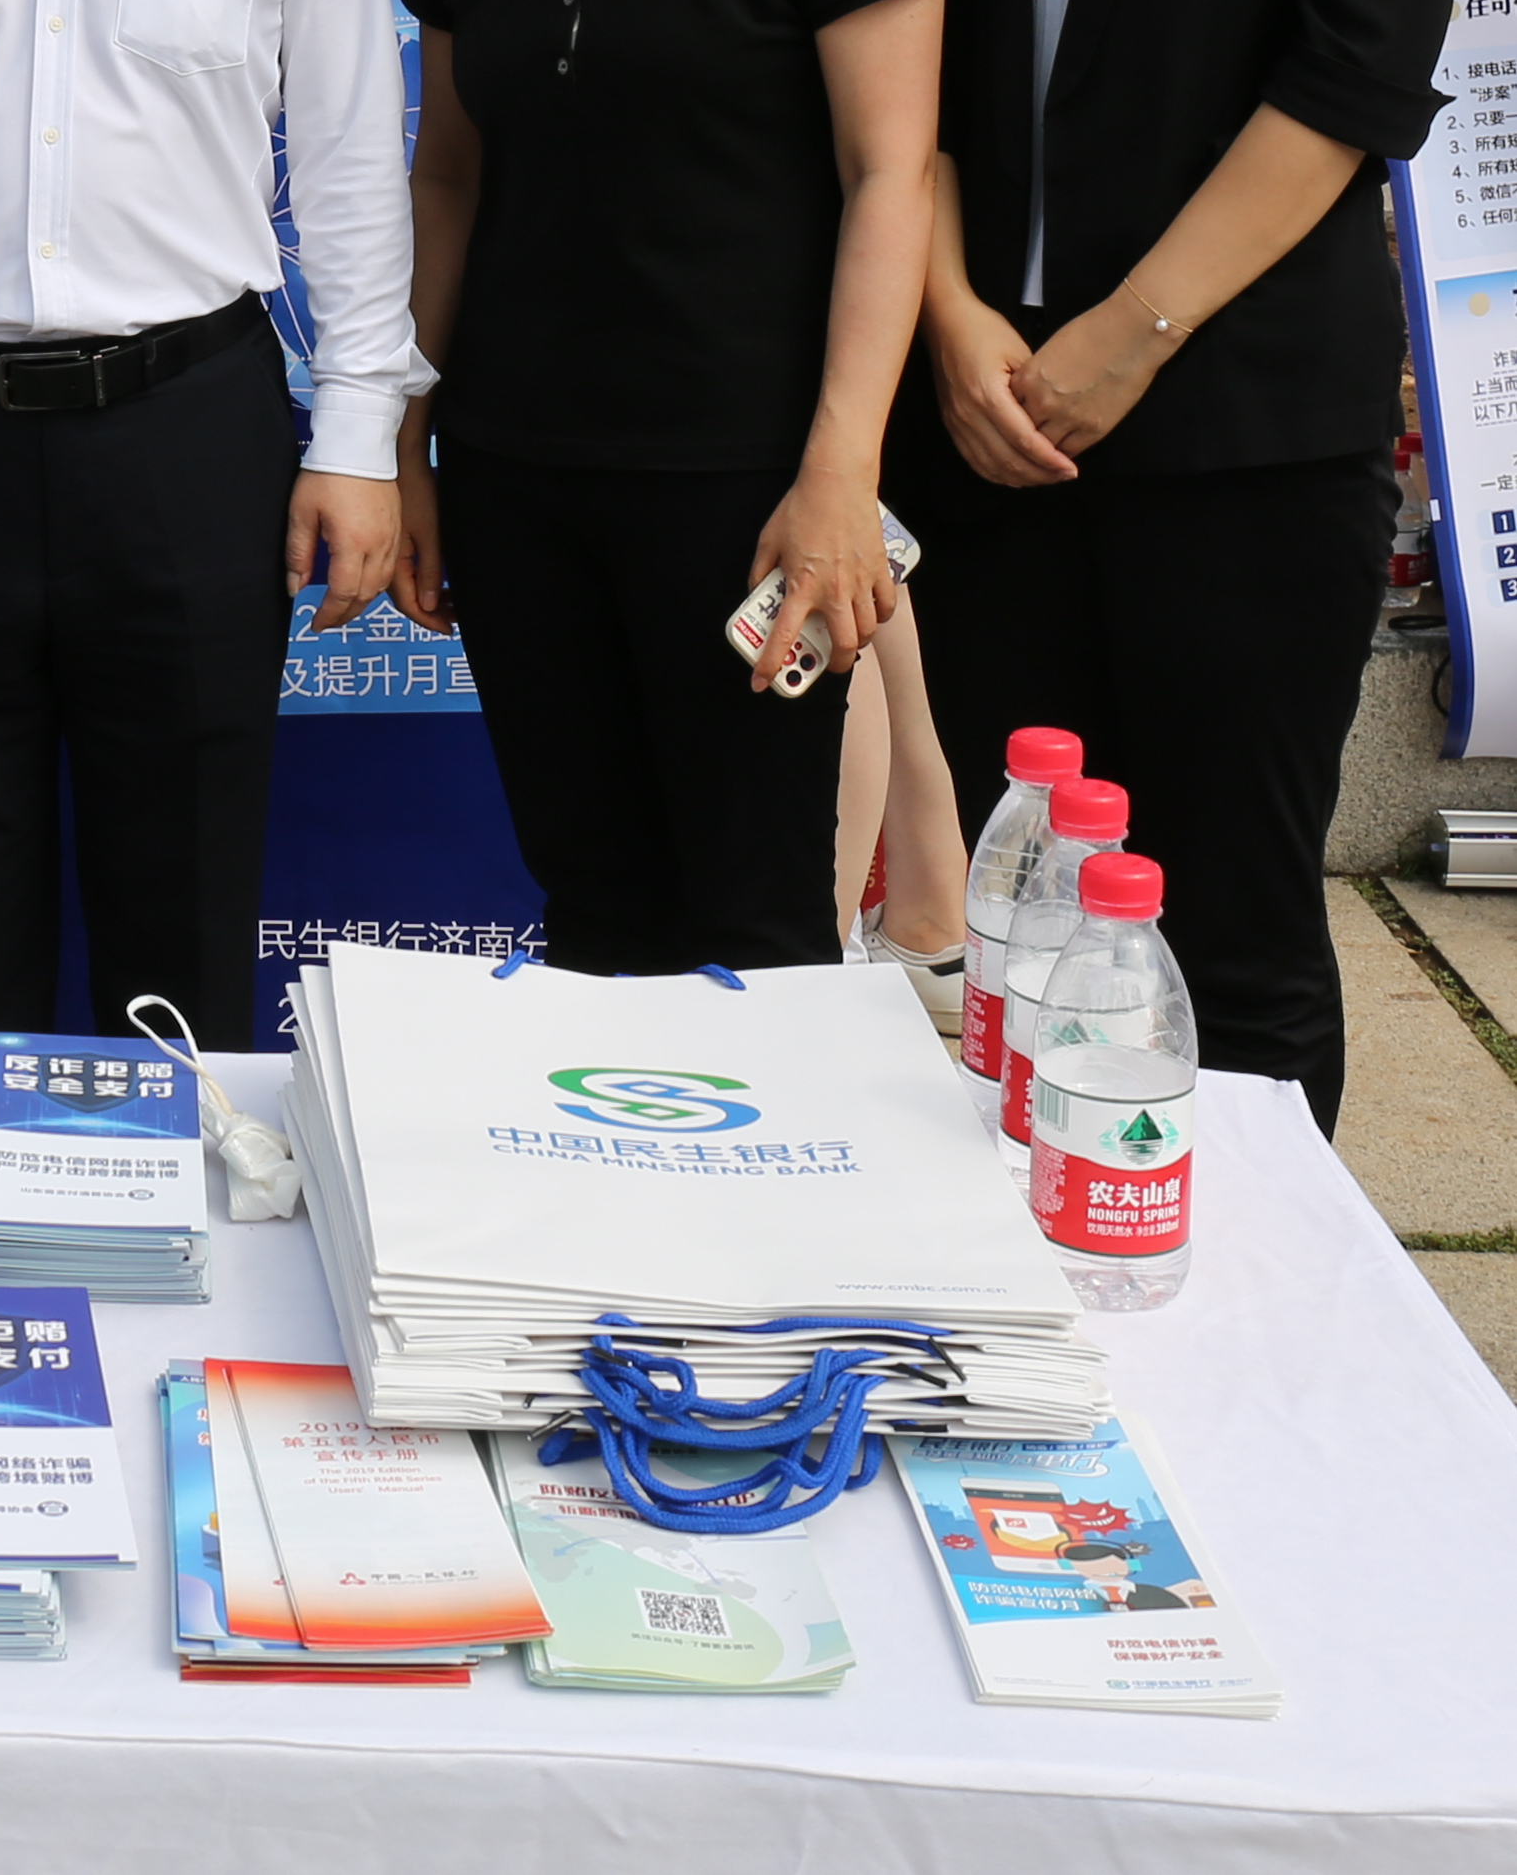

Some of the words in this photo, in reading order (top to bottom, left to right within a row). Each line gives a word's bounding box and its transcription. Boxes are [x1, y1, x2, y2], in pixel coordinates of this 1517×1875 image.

[4, 1054, 174, 1079] 反诈拒赌
[2, 1072, 175, 1099] 安全支付
[486, 1126, 854, 1164] 中国民生银行
[492, 1144, 592, 1163] CHINA
[600, 1156, 765, 1176] MINSHENG
[775, 1163, 863, 1176] BANK
[1087, 1177, 1181, 1208] 农夫山泉
[1087, 1206, 1139, 1224] NONGFU
[1142, 1203, 1180, 1223] SPRING
[834, 1283, 1008, 1294] www.cmbc.com.cn
[281, 1433, 440, 1448] 第五套人民币
[314, 1449, 420, 1462] 宣传手册
[319, 1467, 342, 1475] The
[345, 1467, 375, 1475] 2019
[378, 1466, 421, 1474] Edition
[343, 1476, 371, 1484] Fifth
[406, 1475, 443, 1483] Series
[378, 1485, 424, 1494] Manual
